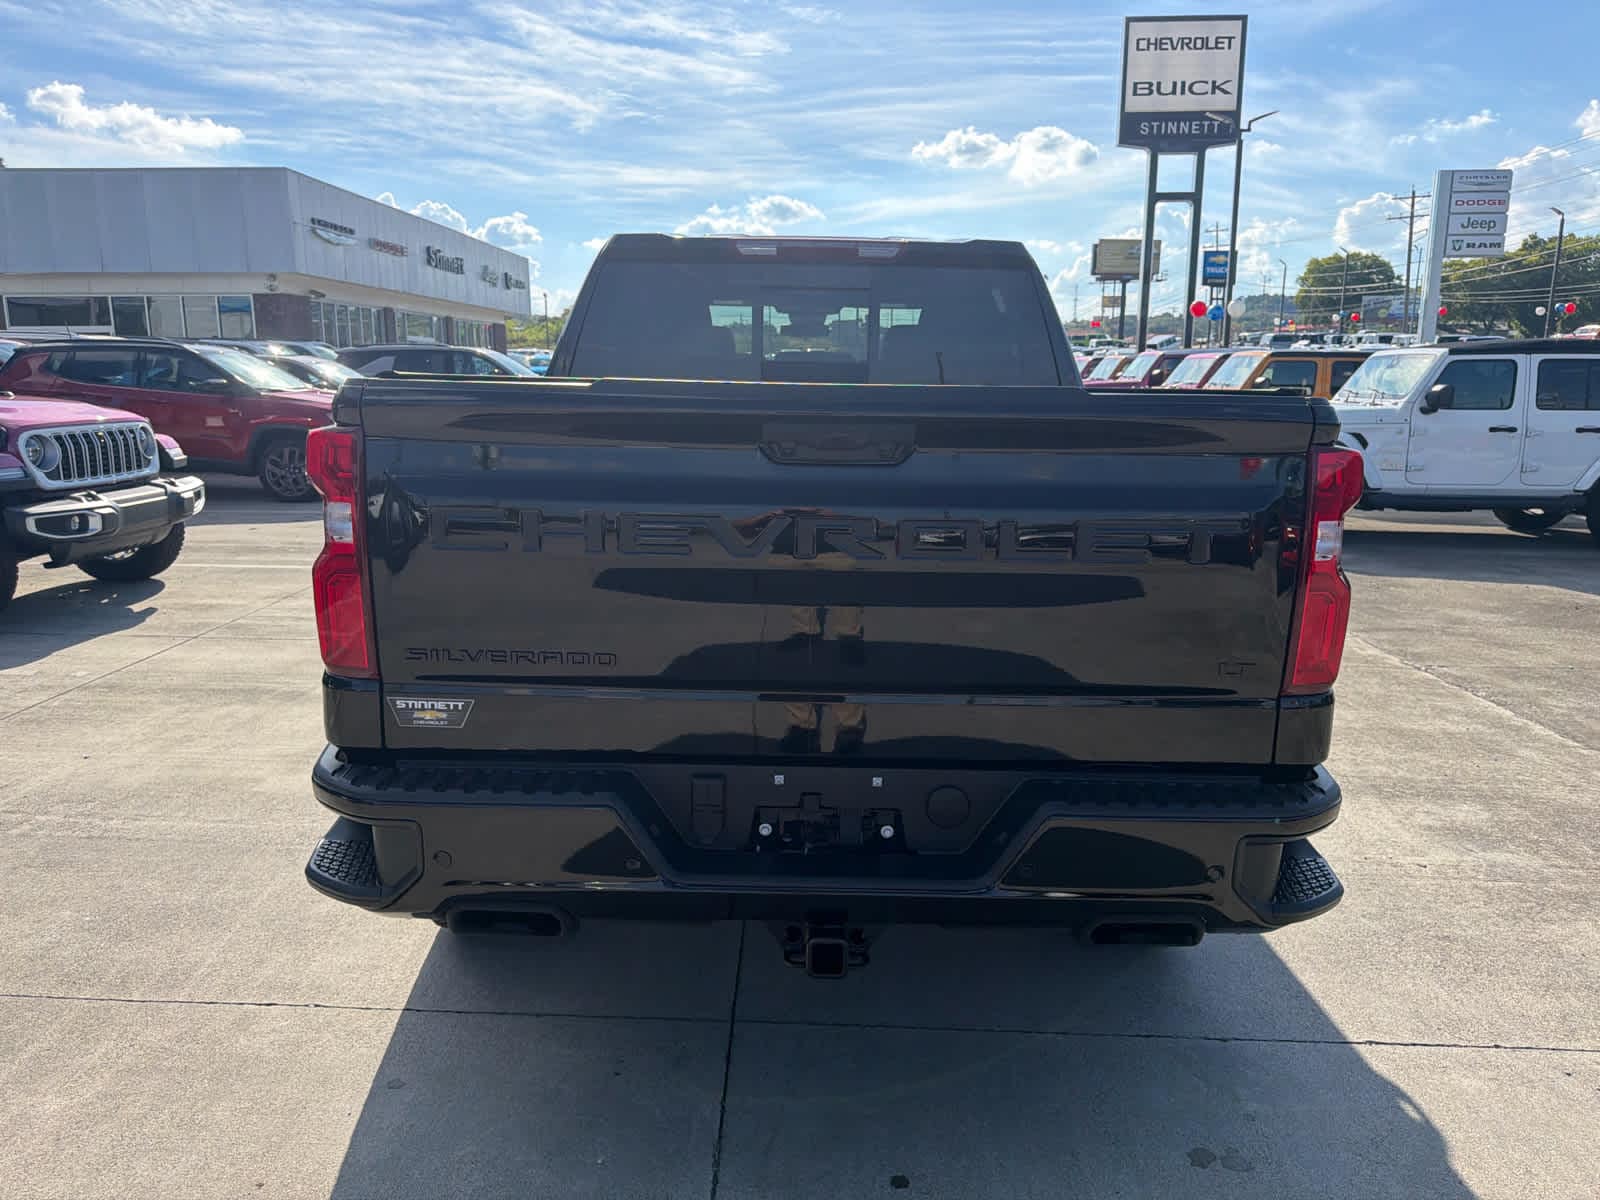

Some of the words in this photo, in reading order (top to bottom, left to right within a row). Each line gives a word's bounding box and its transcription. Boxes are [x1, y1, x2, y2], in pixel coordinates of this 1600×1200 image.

[1135, 36, 1236, 52] CHEVROLET
[1132, 79, 1233, 96] BUICK
[1140, 120, 1219, 135] STINNETT
[1461, 216, 1496, 231] Jeep
[429, 504, 1240, 566] CHEVROLET
[404, 647, 617, 666] SILVERADO
[396, 700, 465, 711] STINNETT
